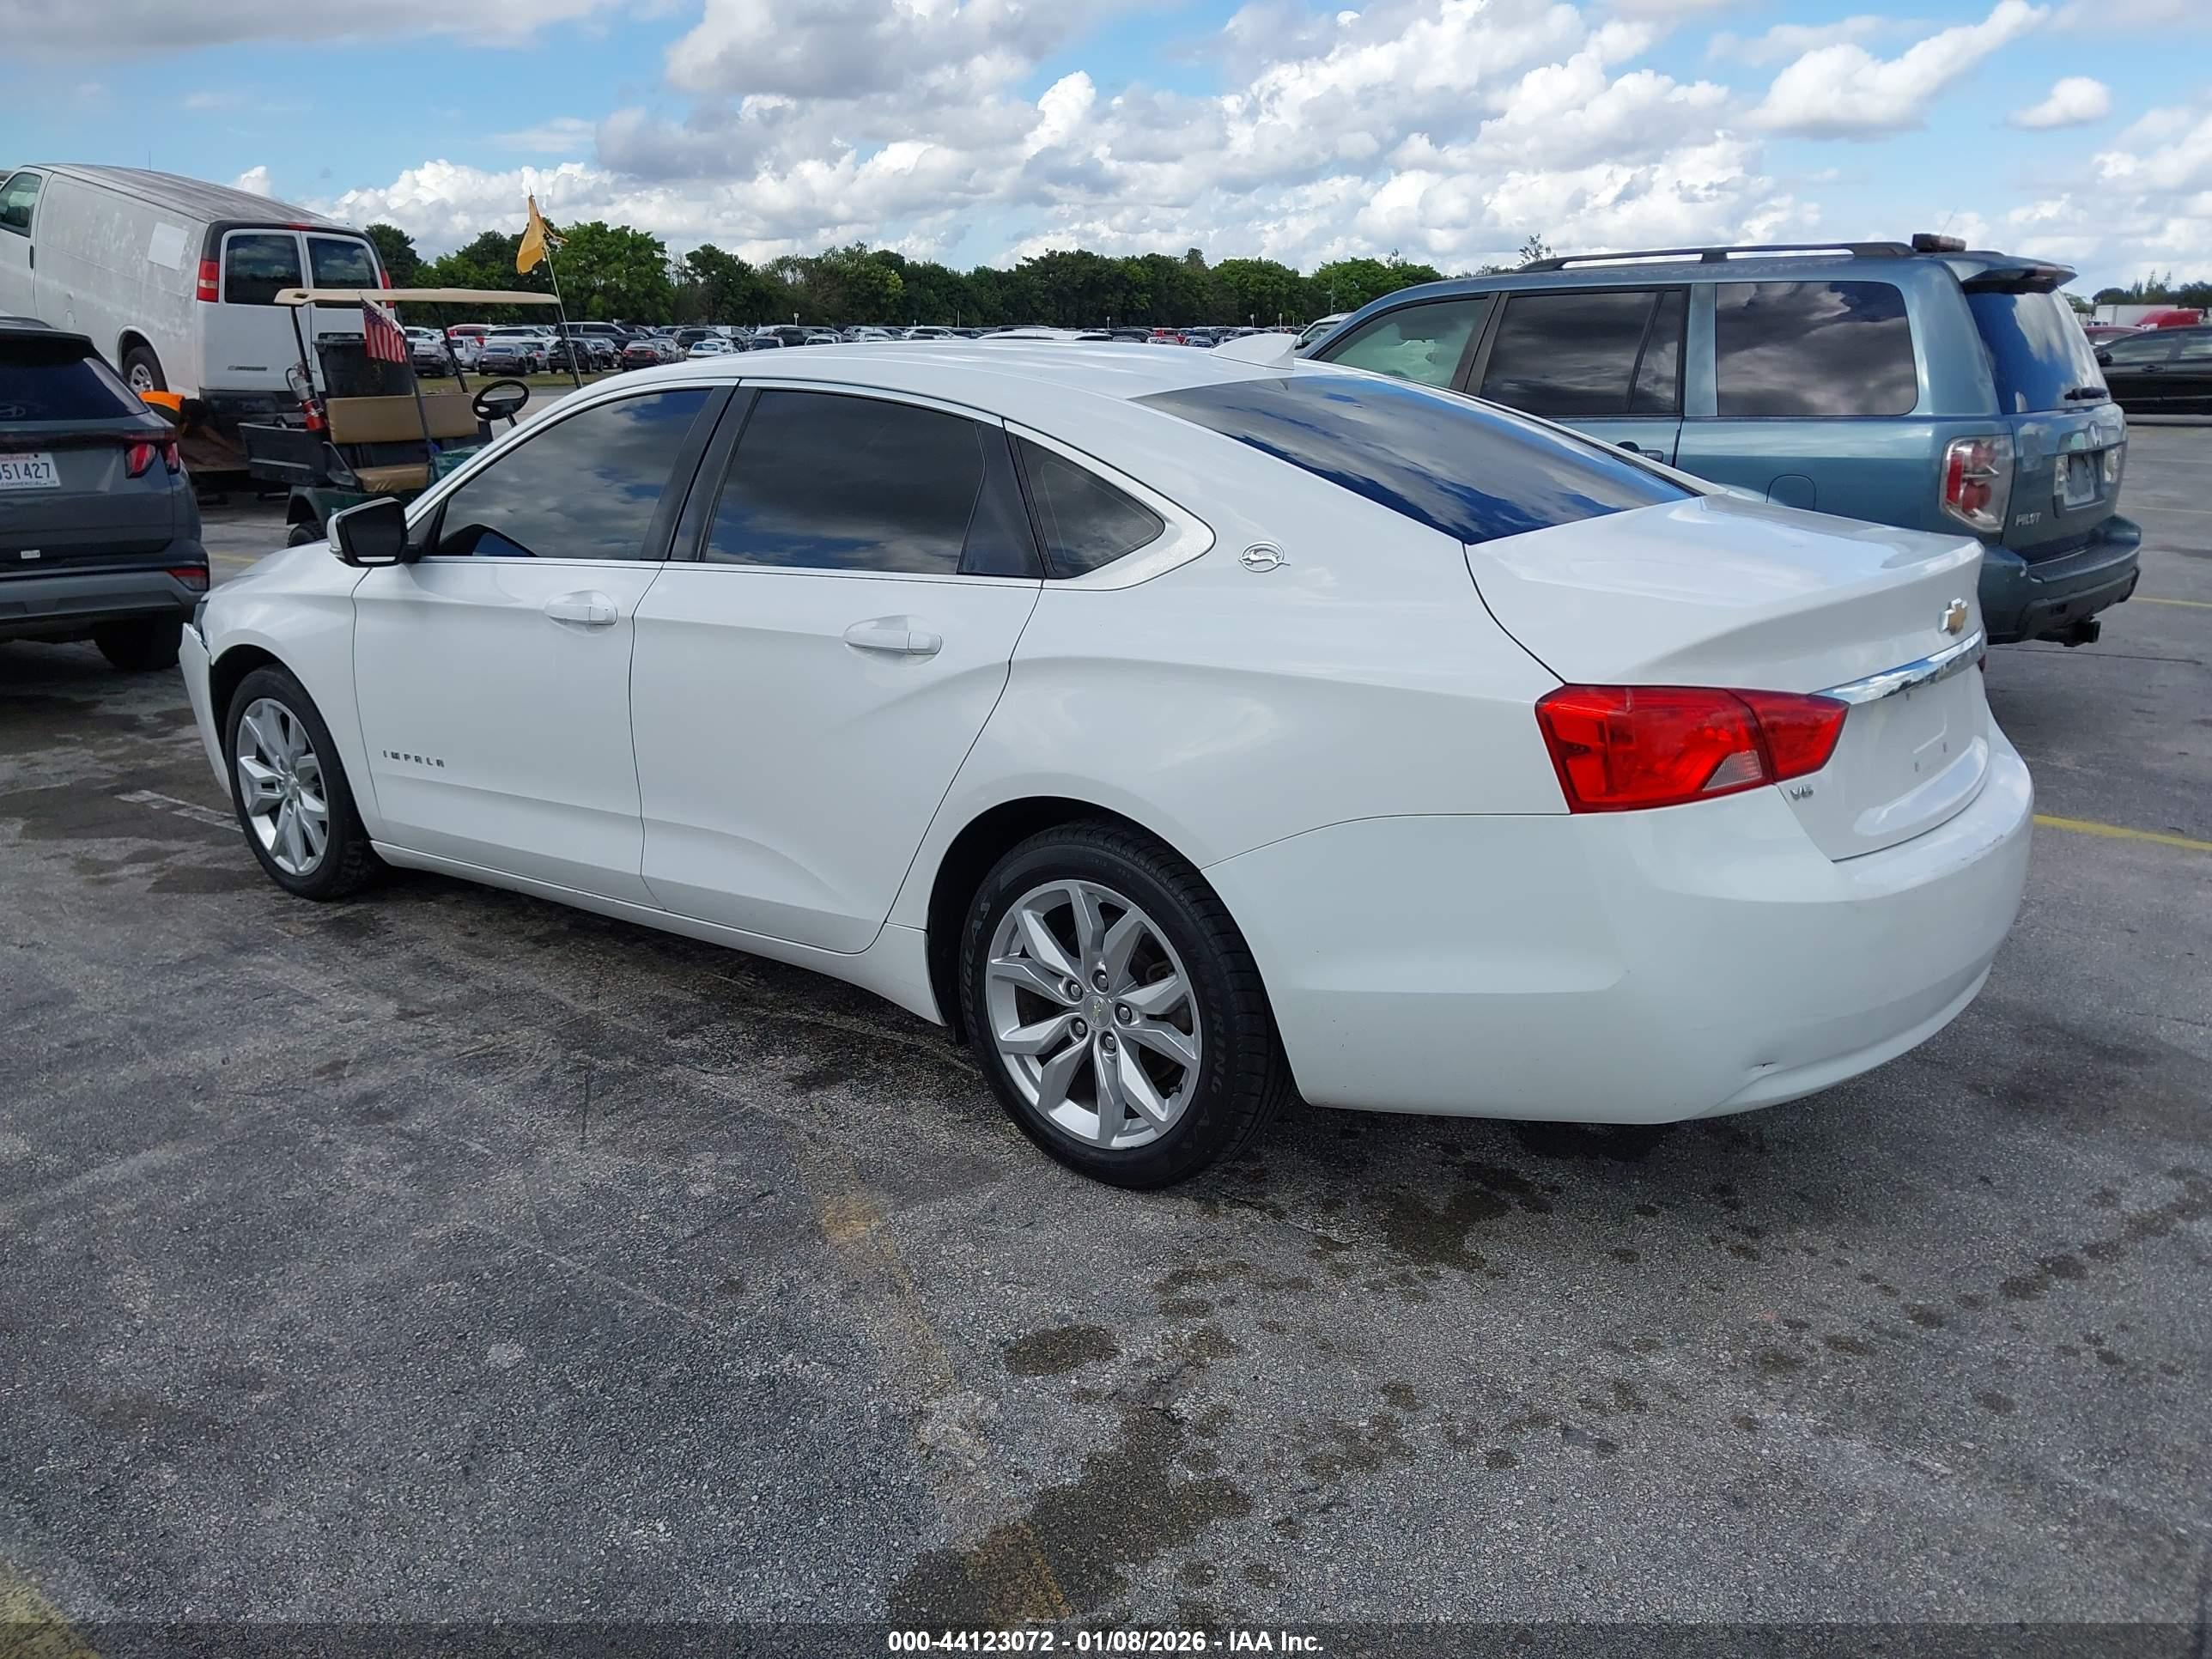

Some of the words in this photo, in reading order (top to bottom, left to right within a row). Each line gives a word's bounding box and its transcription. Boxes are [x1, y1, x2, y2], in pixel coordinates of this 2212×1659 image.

[0, 462, 50, 480] 51427
[383, 750, 445, 768] IMPALA
[1790, 783, 1814, 801] V6
